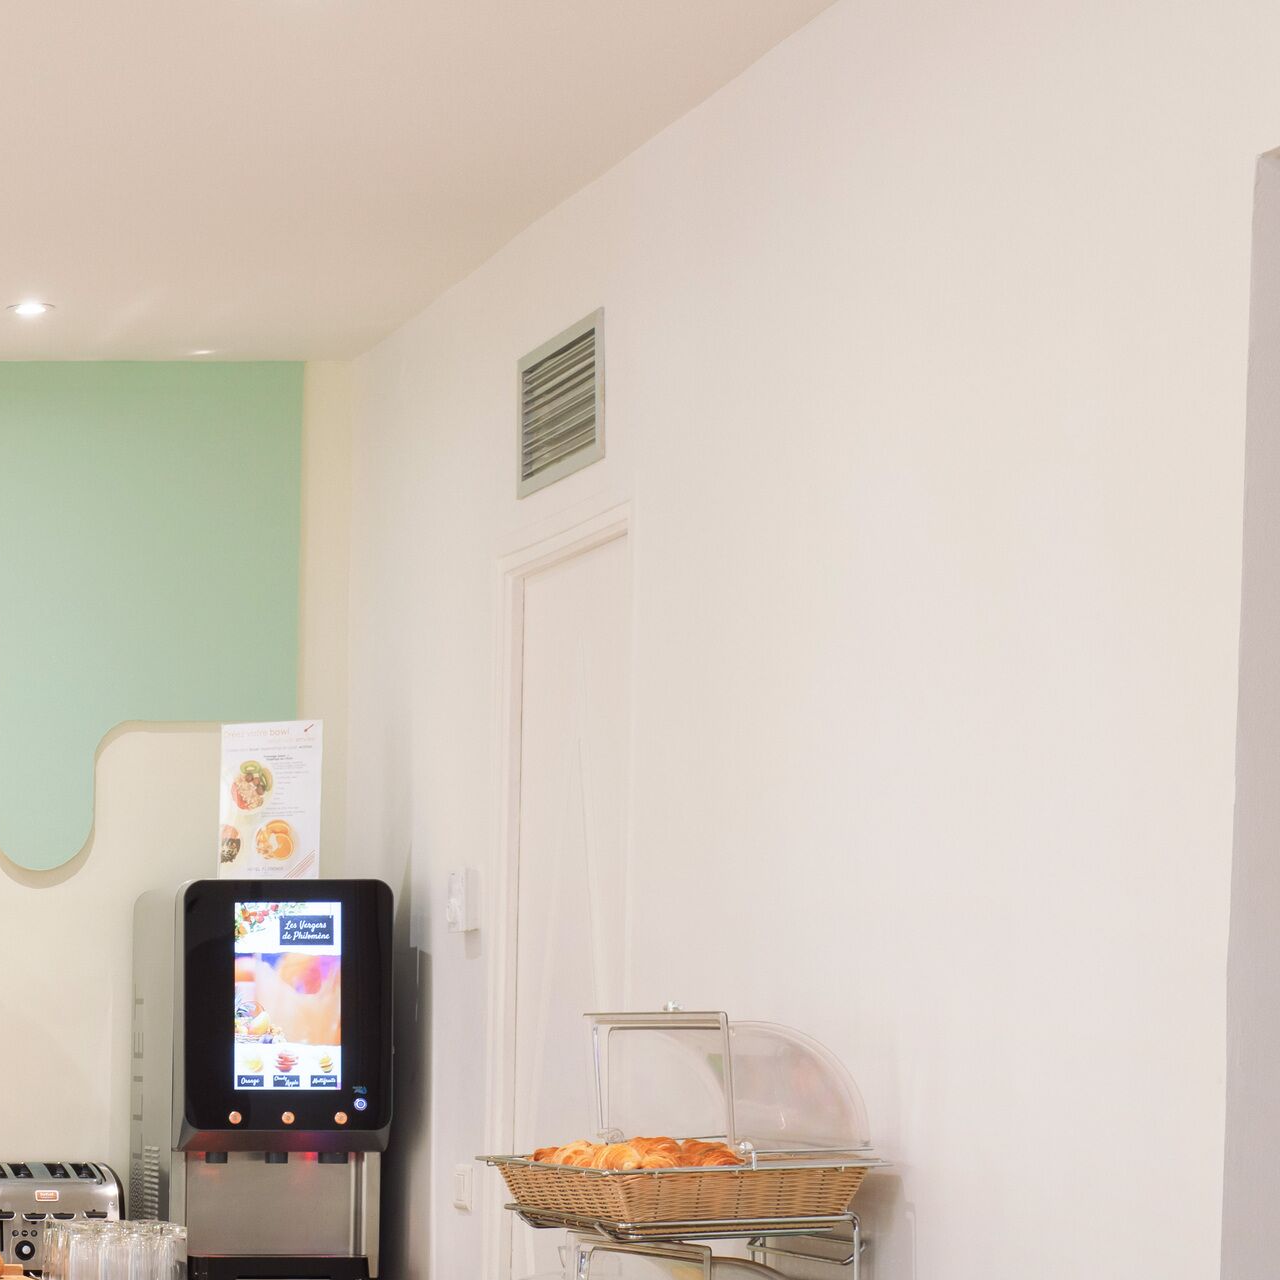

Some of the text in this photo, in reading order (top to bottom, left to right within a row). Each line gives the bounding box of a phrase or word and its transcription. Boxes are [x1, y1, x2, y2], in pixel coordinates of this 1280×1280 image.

[284, 920, 327, 933] Les Vergers
[282, 930, 331, 941] de Philomène
[240, 1077, 260, 1085] Orange
